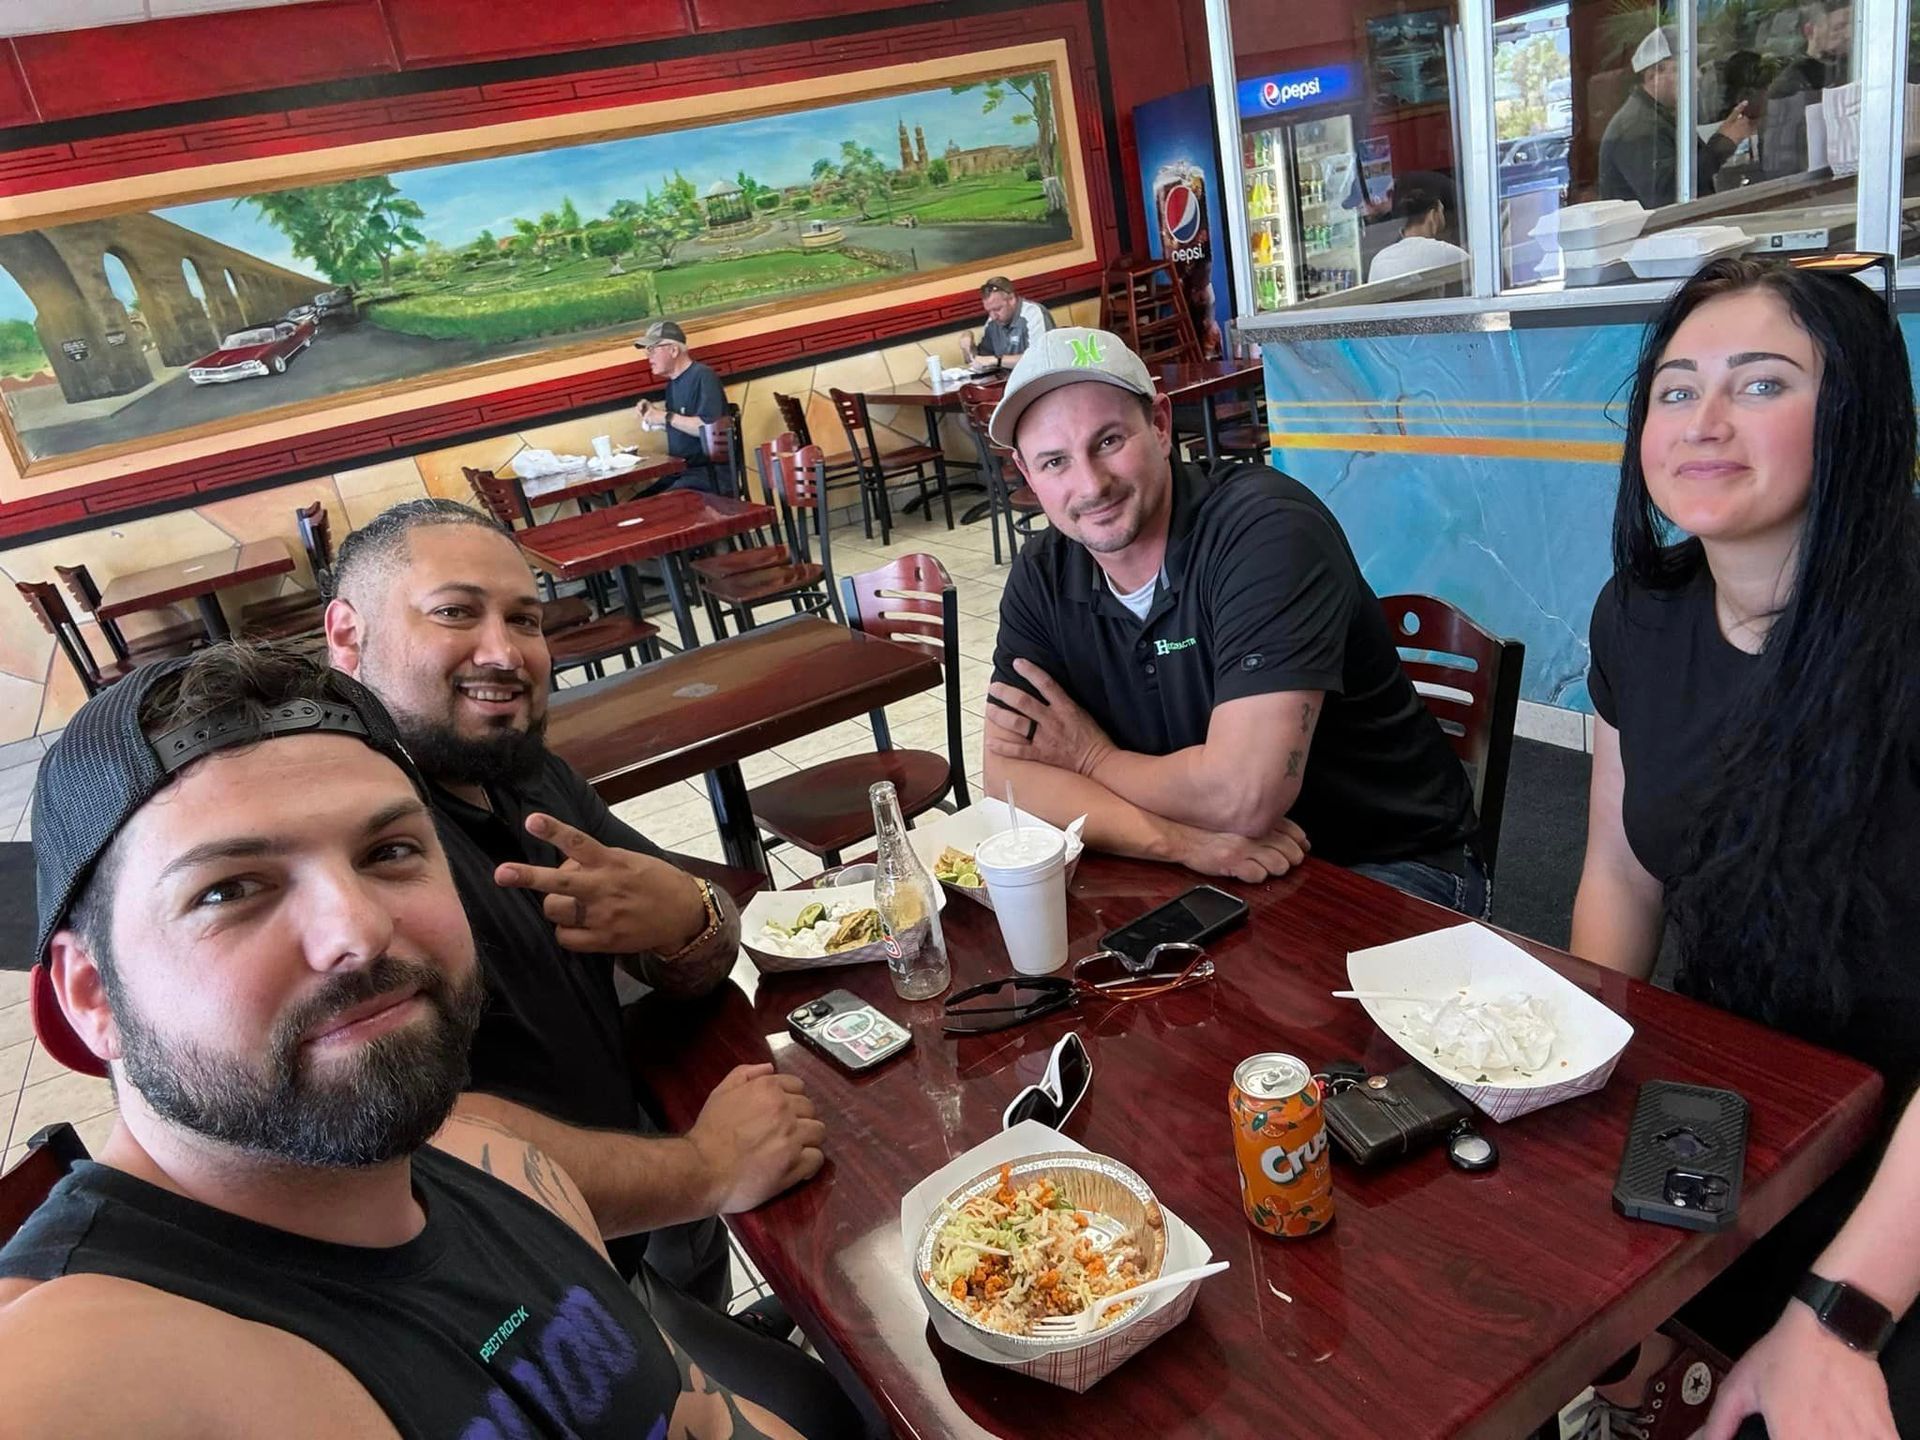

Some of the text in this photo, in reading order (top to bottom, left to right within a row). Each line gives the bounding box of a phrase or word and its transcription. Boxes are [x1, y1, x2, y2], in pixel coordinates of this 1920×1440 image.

[1281, 77, 1320, 103] pepsi
[1171, 243, 1203, 264] pepsi
[498, 1305, 530, 1340] ROCK
